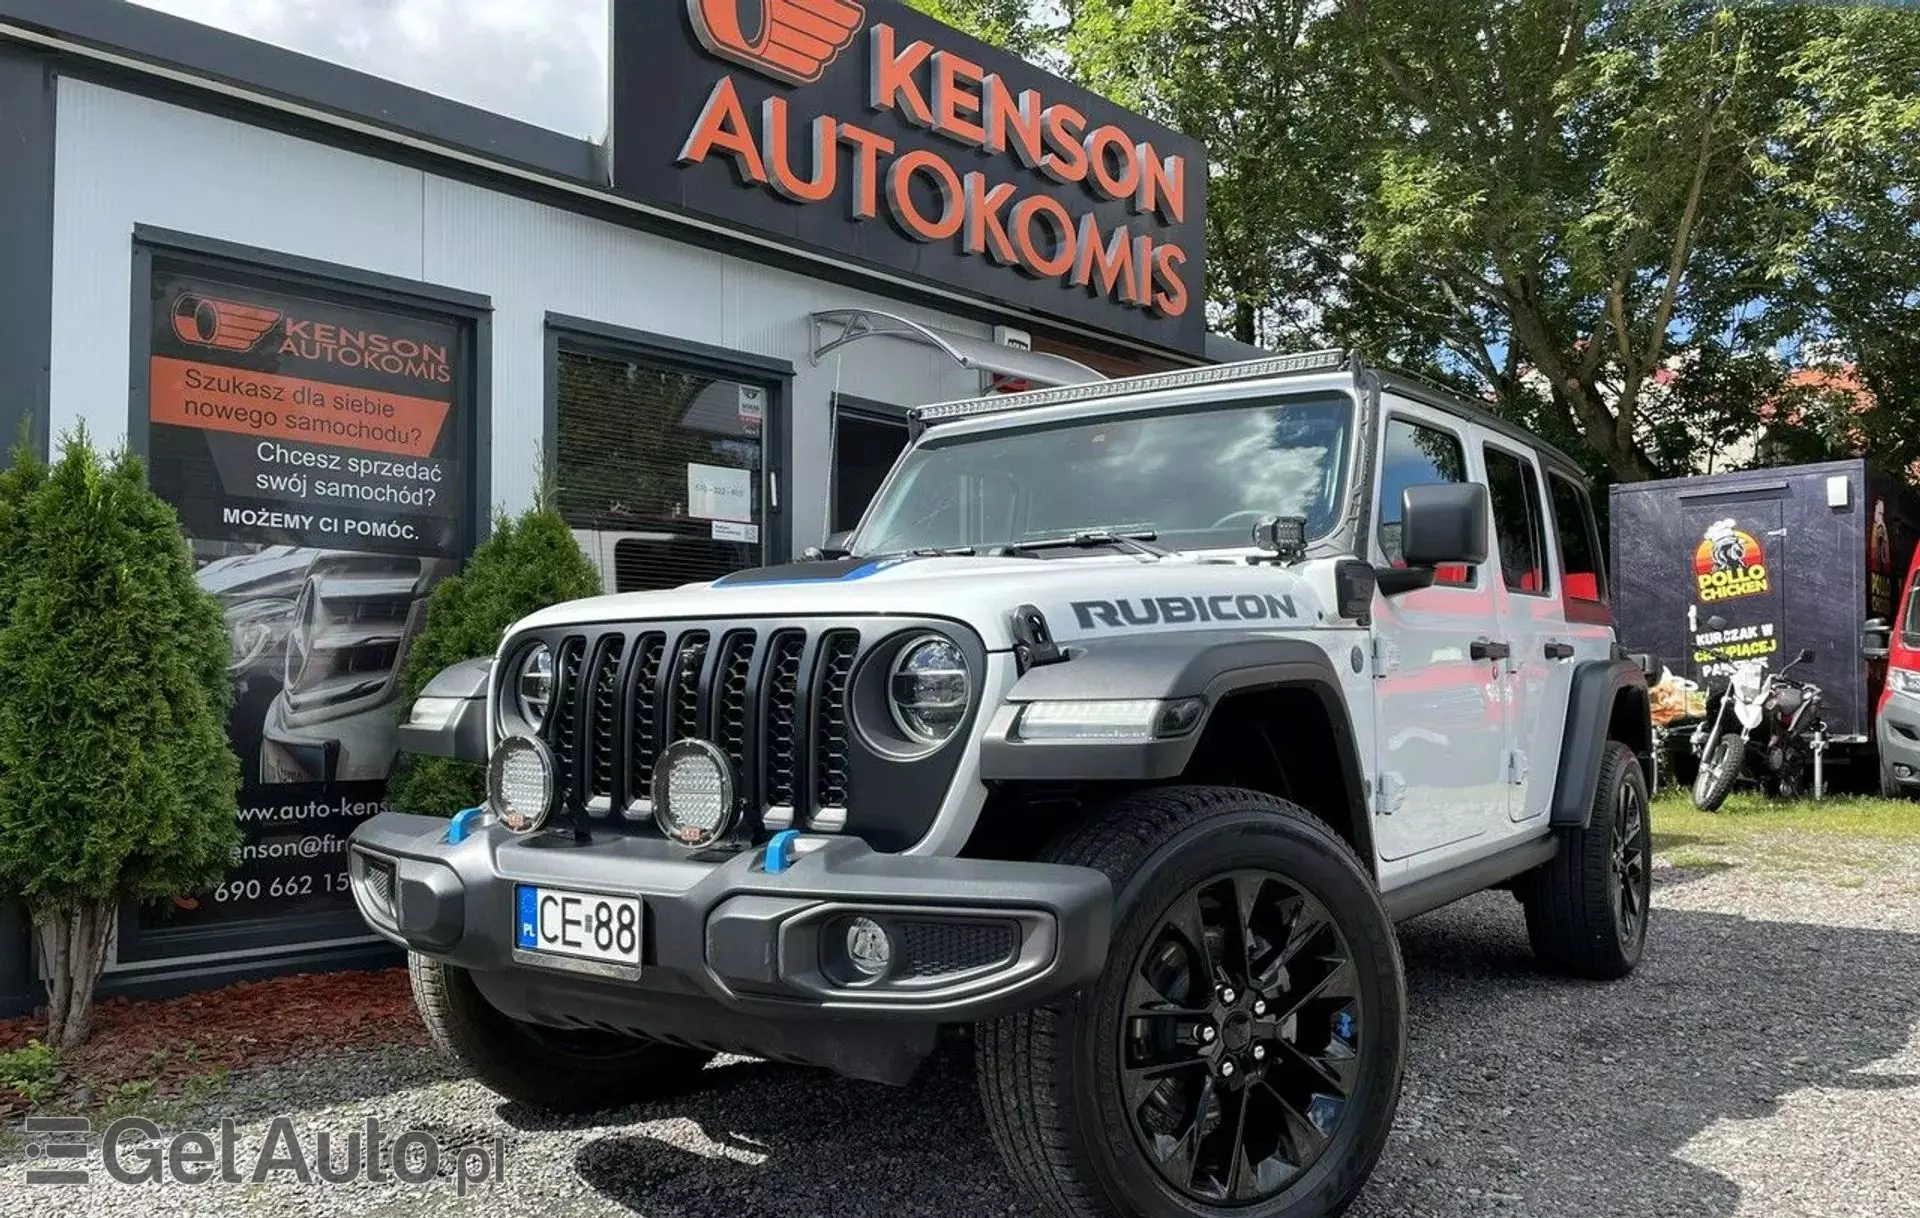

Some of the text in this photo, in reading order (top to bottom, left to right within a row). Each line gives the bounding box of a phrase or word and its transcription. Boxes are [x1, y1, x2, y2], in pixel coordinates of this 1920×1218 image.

[871, 23, 1184, 225] KENSON
[676, 75, 1188, 317] AUTOKOMIS
[285, 317, 447, 364] KENSON
[277, 337, 451, 382] AUTOKOMIS
[184, 369, 395, 418] Szukasz dla siebie
[184, 400, 422, 445] nowego samochodu?
[257, 442, 442, 482] Chcesz sprzedać
[256, 472, 436, 506] swój samochód?
[223, 508, 419, 540] MOŻEMY CI POMÓC.
[1697, 565, 1766, 589] POLLO
[1700, 579, 1768, 601] CHICKEN
[1070, 594, 1297, 629] RUBICON
[1696, 623, 1773, 646] KURCZAK W
[236, 796, 394, 821] ww.auto-kens
[231, 834, 346, 859] enson@fir
[214, 872, 349, 901] 690 662 15
[523, 923, 535, 938] PL
[540, 895, 636, 954] CE 88
